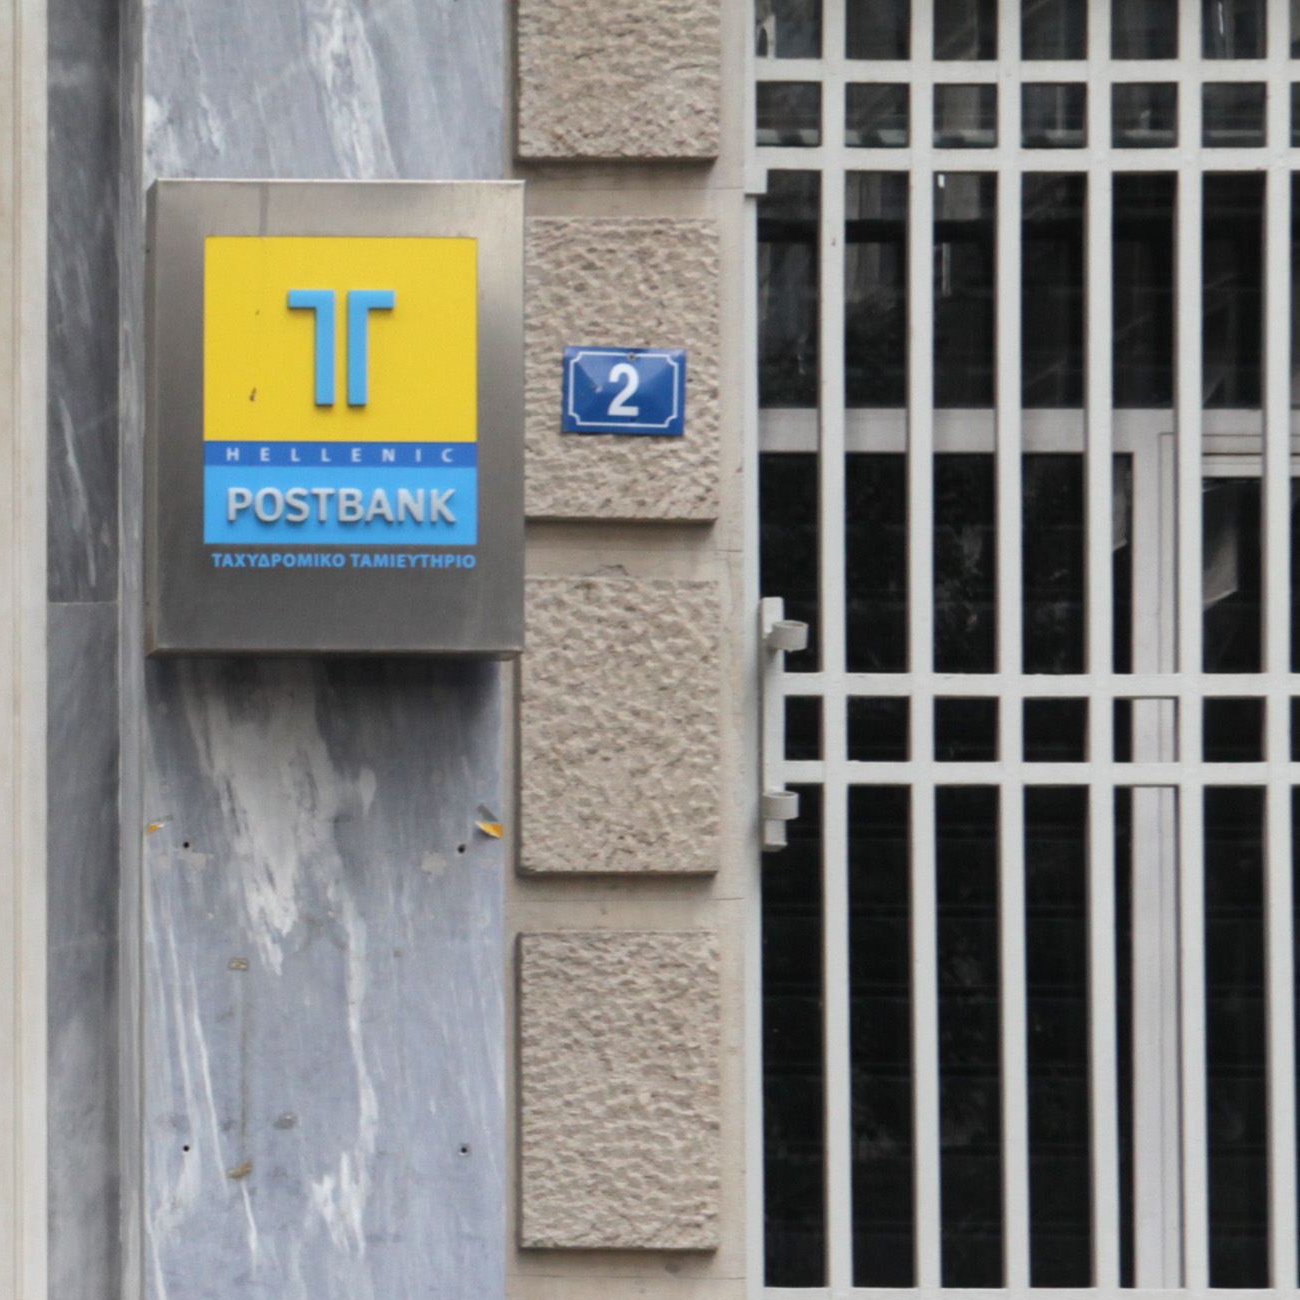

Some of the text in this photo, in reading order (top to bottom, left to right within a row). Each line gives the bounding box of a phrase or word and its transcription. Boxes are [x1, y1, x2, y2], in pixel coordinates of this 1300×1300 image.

[607, 363, 639, 416] 2
[226, 447, 453, 463] HELLENIC
[227, 486, 457, 524] POSTBANK
[212, 552, 477, 569] ΤΑΧΥΔΡΟΜΙΚΟ ΤΑΜΙΕΥΤΗΡΙΟ
